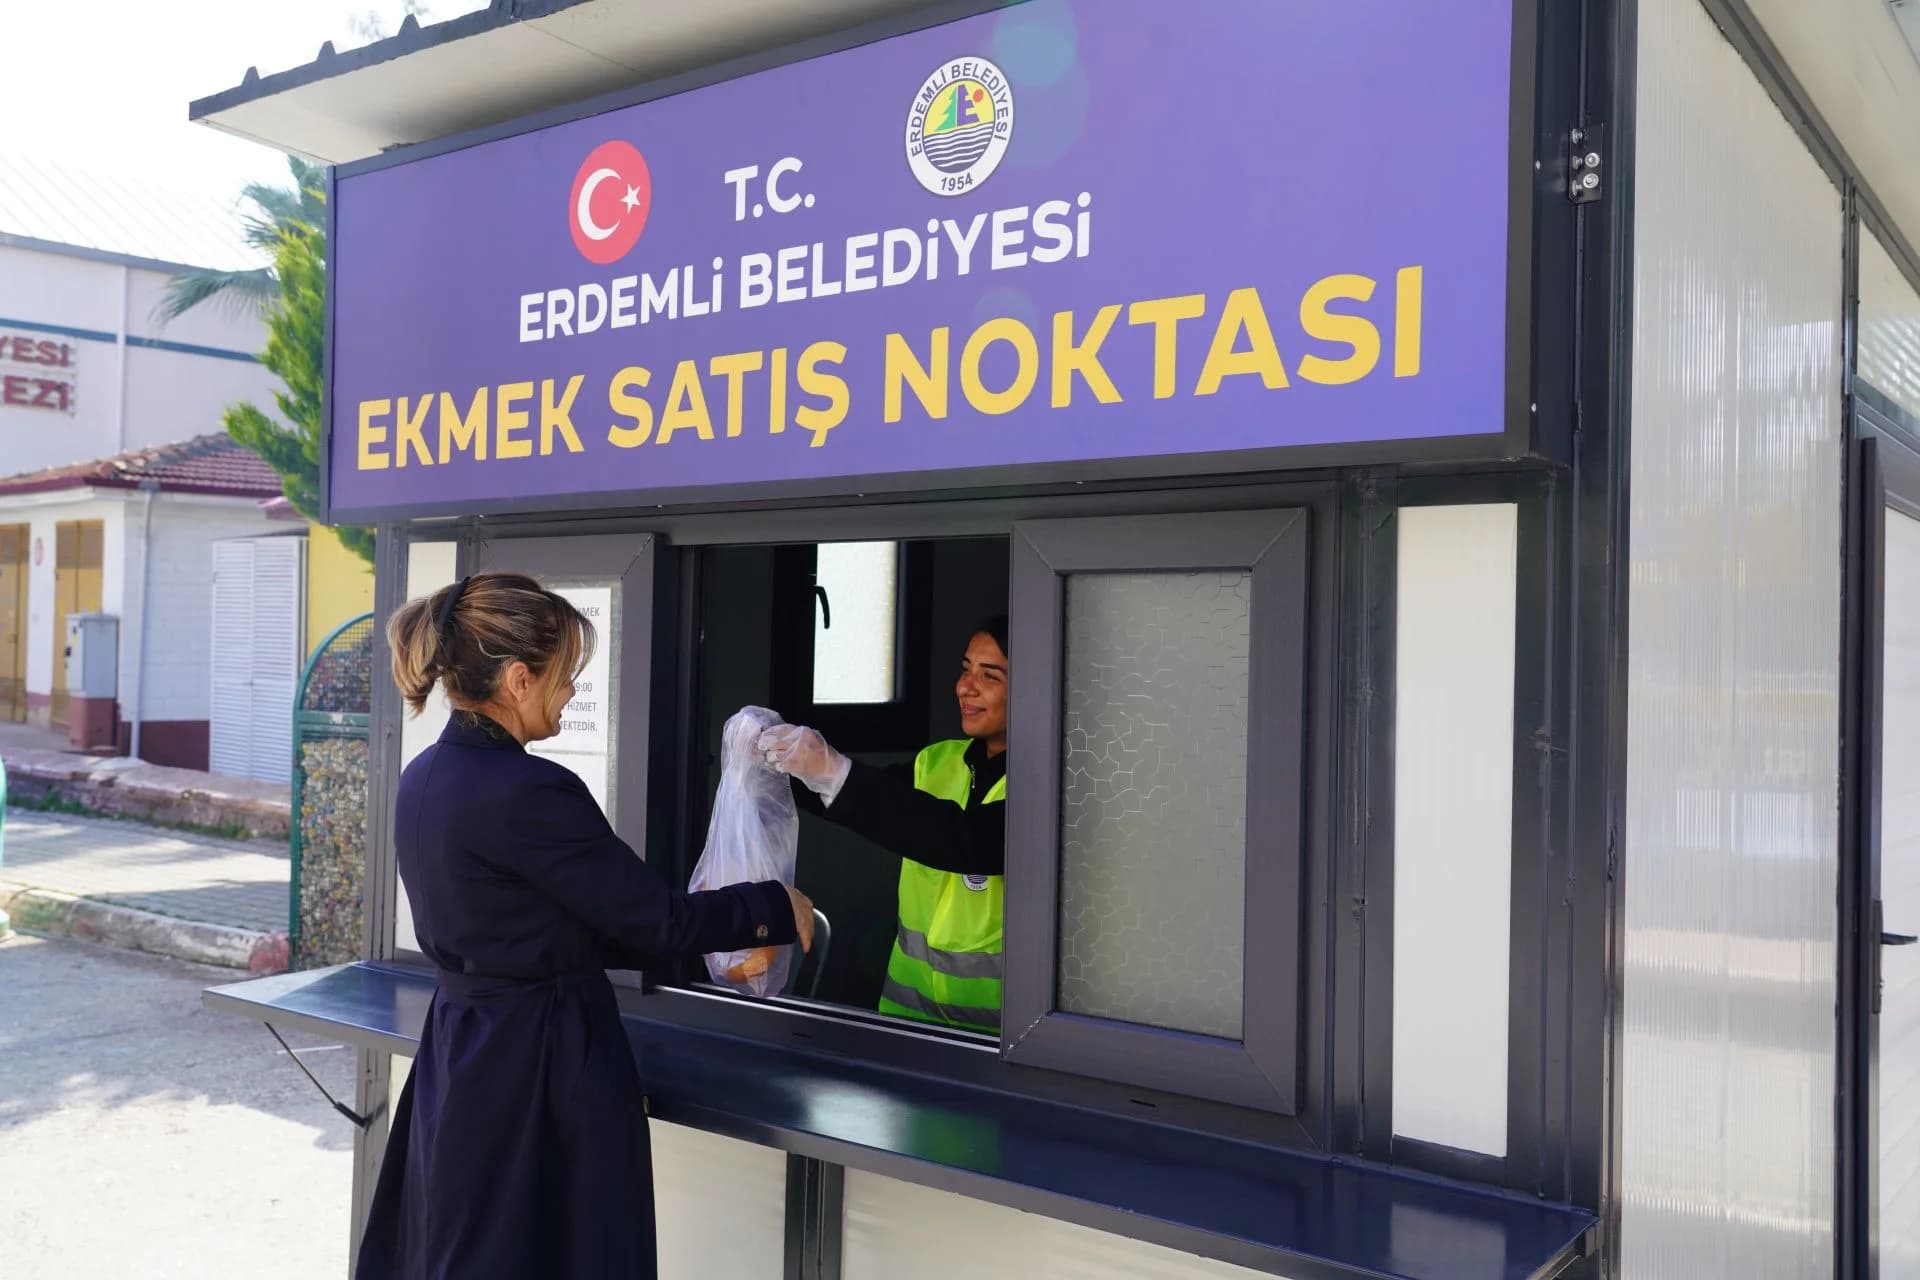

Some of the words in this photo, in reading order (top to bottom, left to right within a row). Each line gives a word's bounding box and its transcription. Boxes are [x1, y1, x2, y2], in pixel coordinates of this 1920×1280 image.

[725, 157, 816, 221] T.C.
[940, 171, 974, 192] 1954
[357, 374, 584, 470] EKMEK
[607, 342, 850, 448] SATIŞ
[883, 265, 1423, 423] NOKTASI
